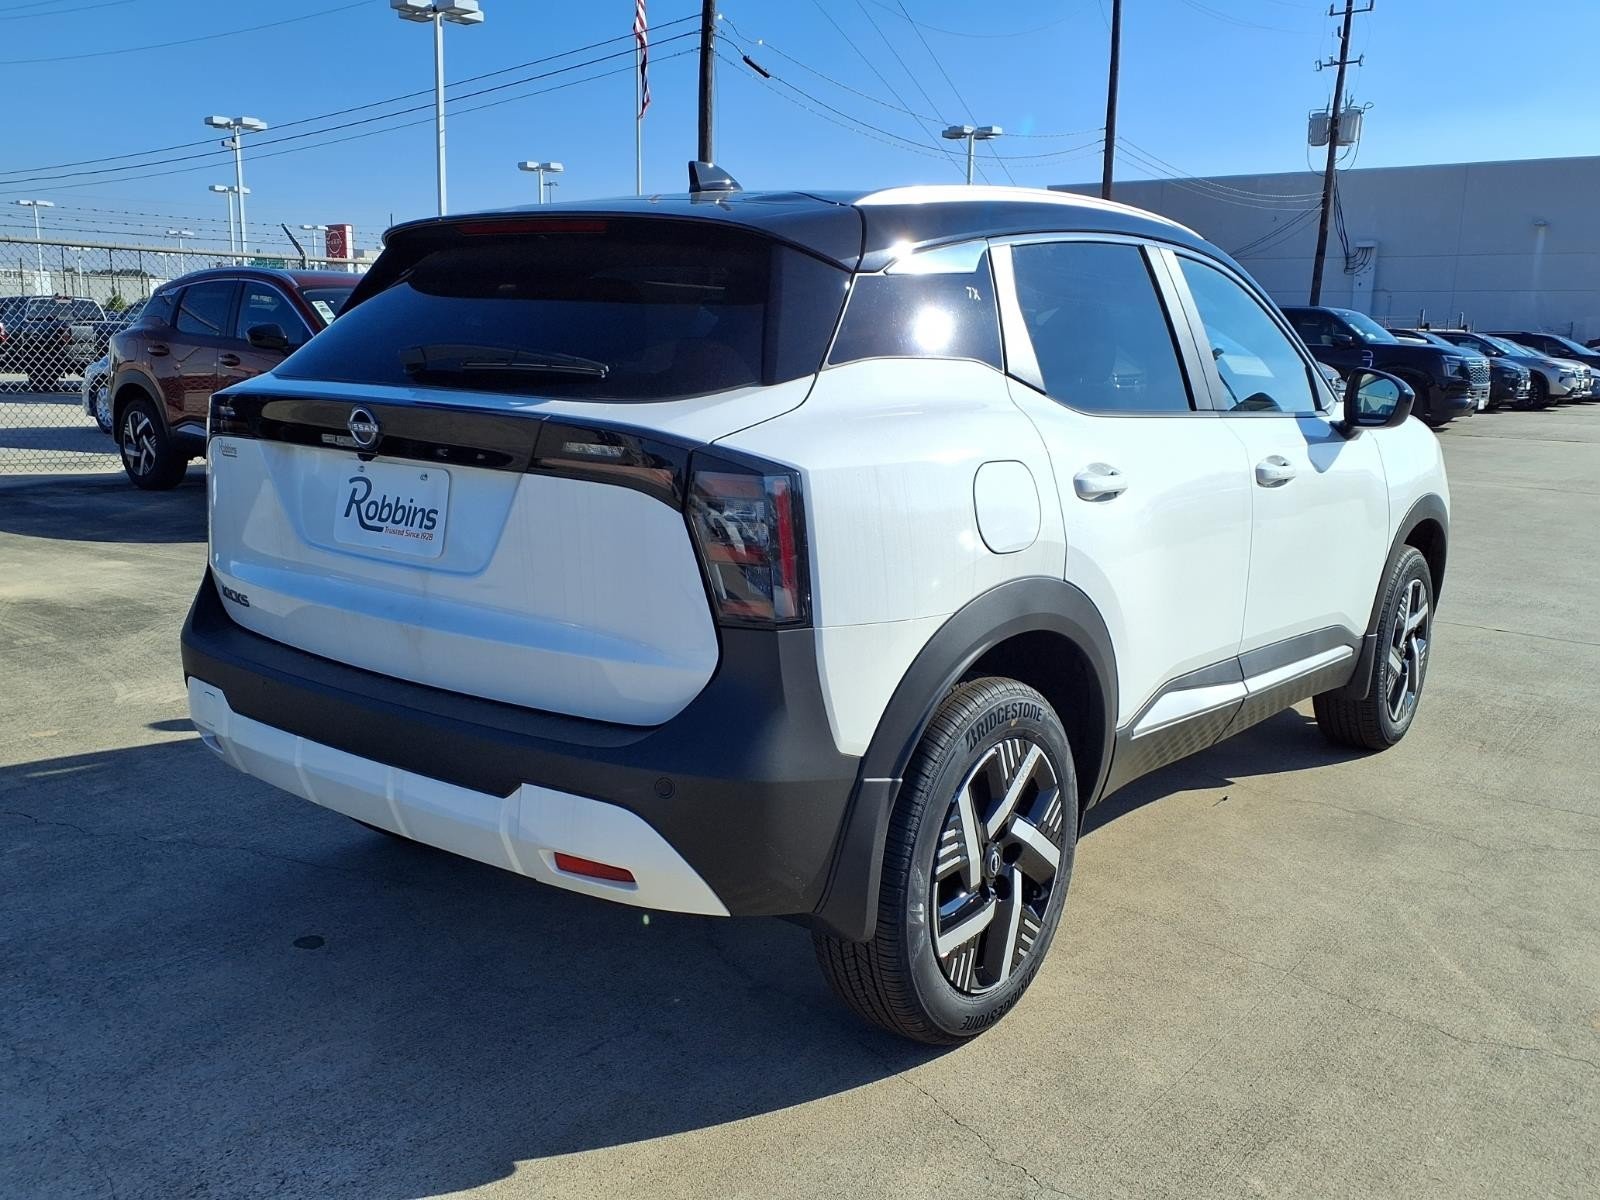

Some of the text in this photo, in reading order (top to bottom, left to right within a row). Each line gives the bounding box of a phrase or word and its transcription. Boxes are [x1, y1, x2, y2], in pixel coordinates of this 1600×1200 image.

[965, 286, 982, 301] TX
[344, 476, 439, 533] Robbins
[385, 526, 404, 536] Trusted
[405, 529, 420, 539] Since
[965, 702, 1044, 753] BRIDGESTONE
